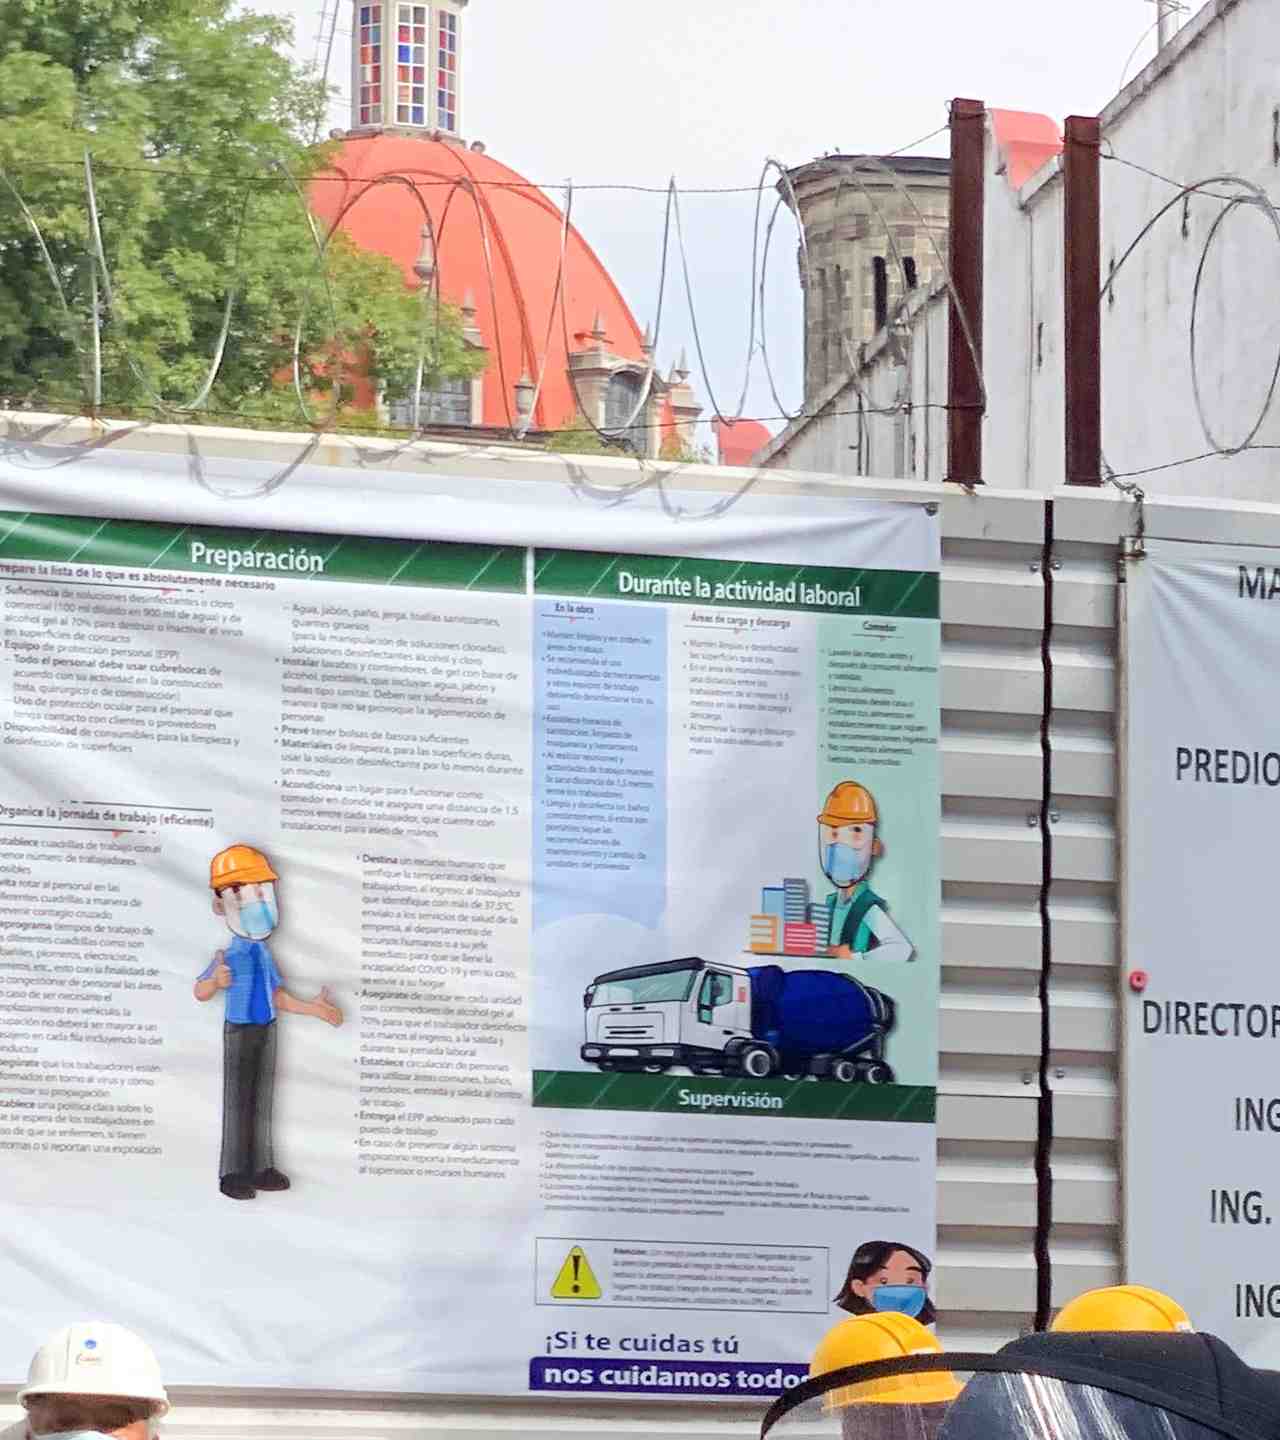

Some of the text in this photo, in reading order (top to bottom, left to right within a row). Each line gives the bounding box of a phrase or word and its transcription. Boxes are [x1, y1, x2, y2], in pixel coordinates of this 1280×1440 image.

[190, 541, 325, 573] Preparación
[0, 563, 275, 591] repare la lista de lo que es absolutamente necesario
[618, 571, 861, 606] Durante la actividad laboral
[5, 640, 39, 652] Equipo
[15, 654, 39, 664] Todo
[41, 656, 50, 664] el
[52, 658, 96, 667] personal
[98, 659, 123, 669] debe
[46, 807, 56, 818] la
[58, 807, 99, 821] jornada
[102, 810, 115, 820] de
[119, 811, 156, 825] trabajo
[160, 813, 214, 828] (eficiente)
[679, 1089, 782, 1109] Supervisión
[1211, 1189, 1270, 1224] ING.
[546, 1331, 738, 1353] ¡Si te cuidas tú
[544, 1368, 593, 1384] nos
[599, 1365, 730, 1387] cuidamos
